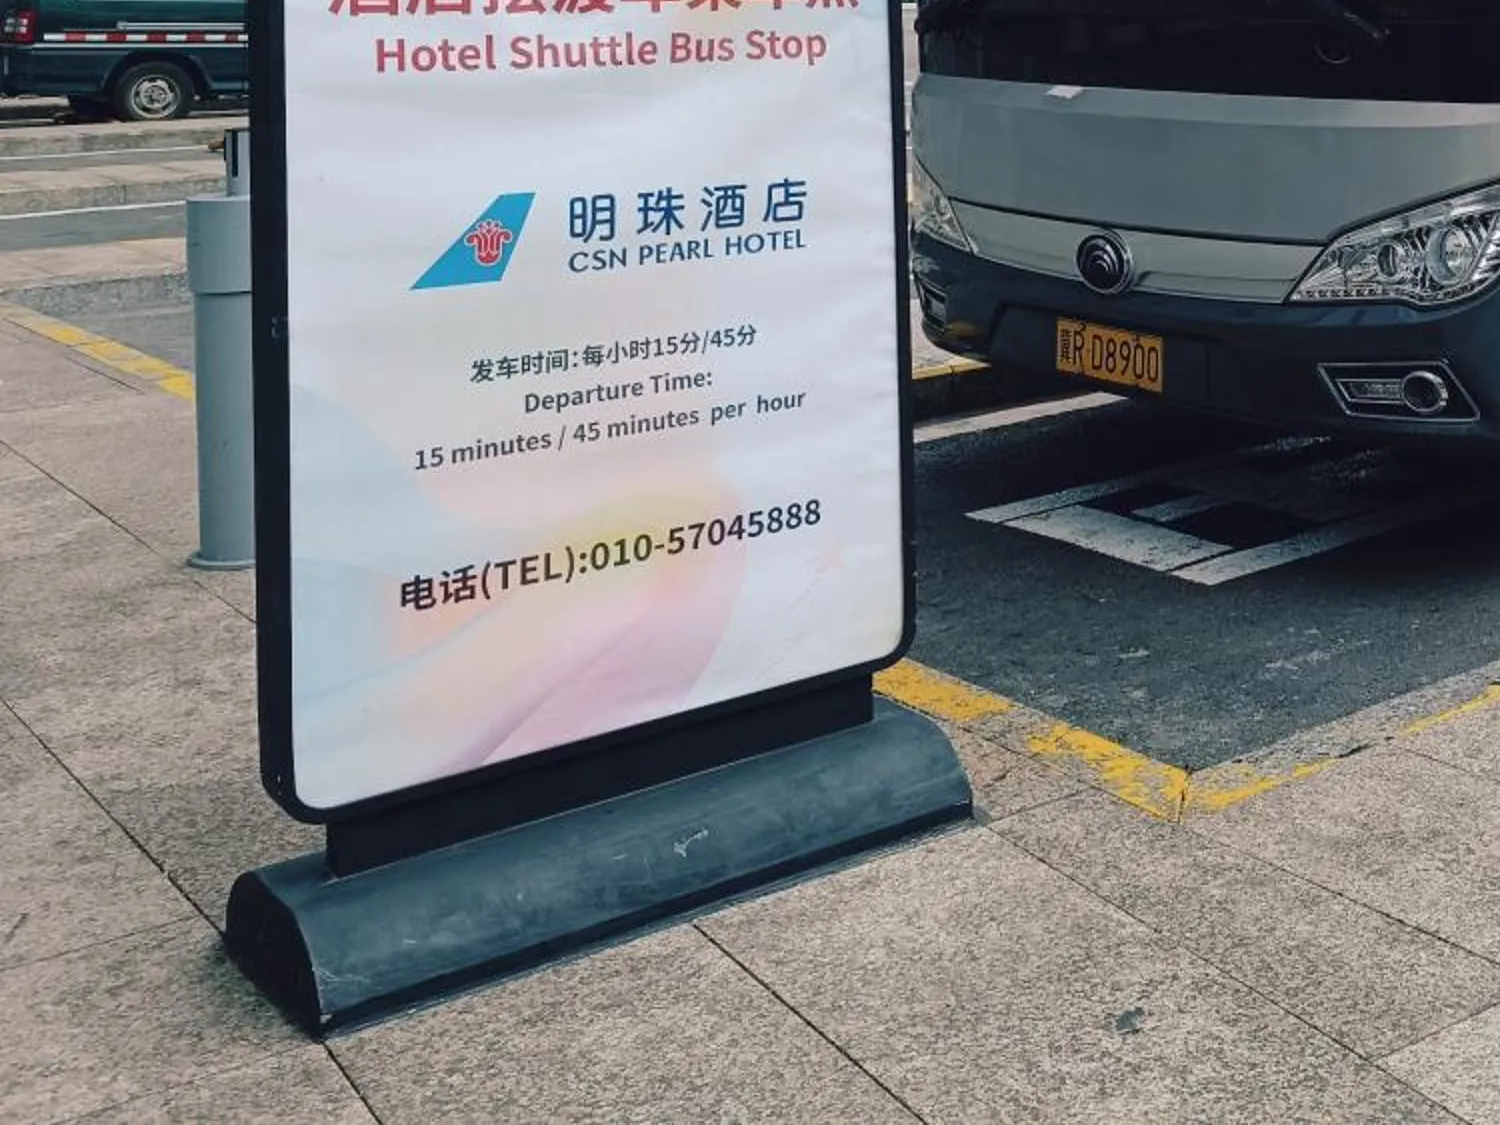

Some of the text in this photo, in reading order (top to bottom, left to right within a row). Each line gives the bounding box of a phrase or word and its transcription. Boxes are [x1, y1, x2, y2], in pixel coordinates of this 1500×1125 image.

[375, 29, 828, 73] Hotel Shuttle Bus Stop
[569, 177, 807, 243] 明珠酒店
[568, 229, 806, 274] CSN PEARL HOTEL
[524, 369, 713, 414] Departure Time:
[415, 390, 807, 471] 15 minutes / 45 minutes per hour
